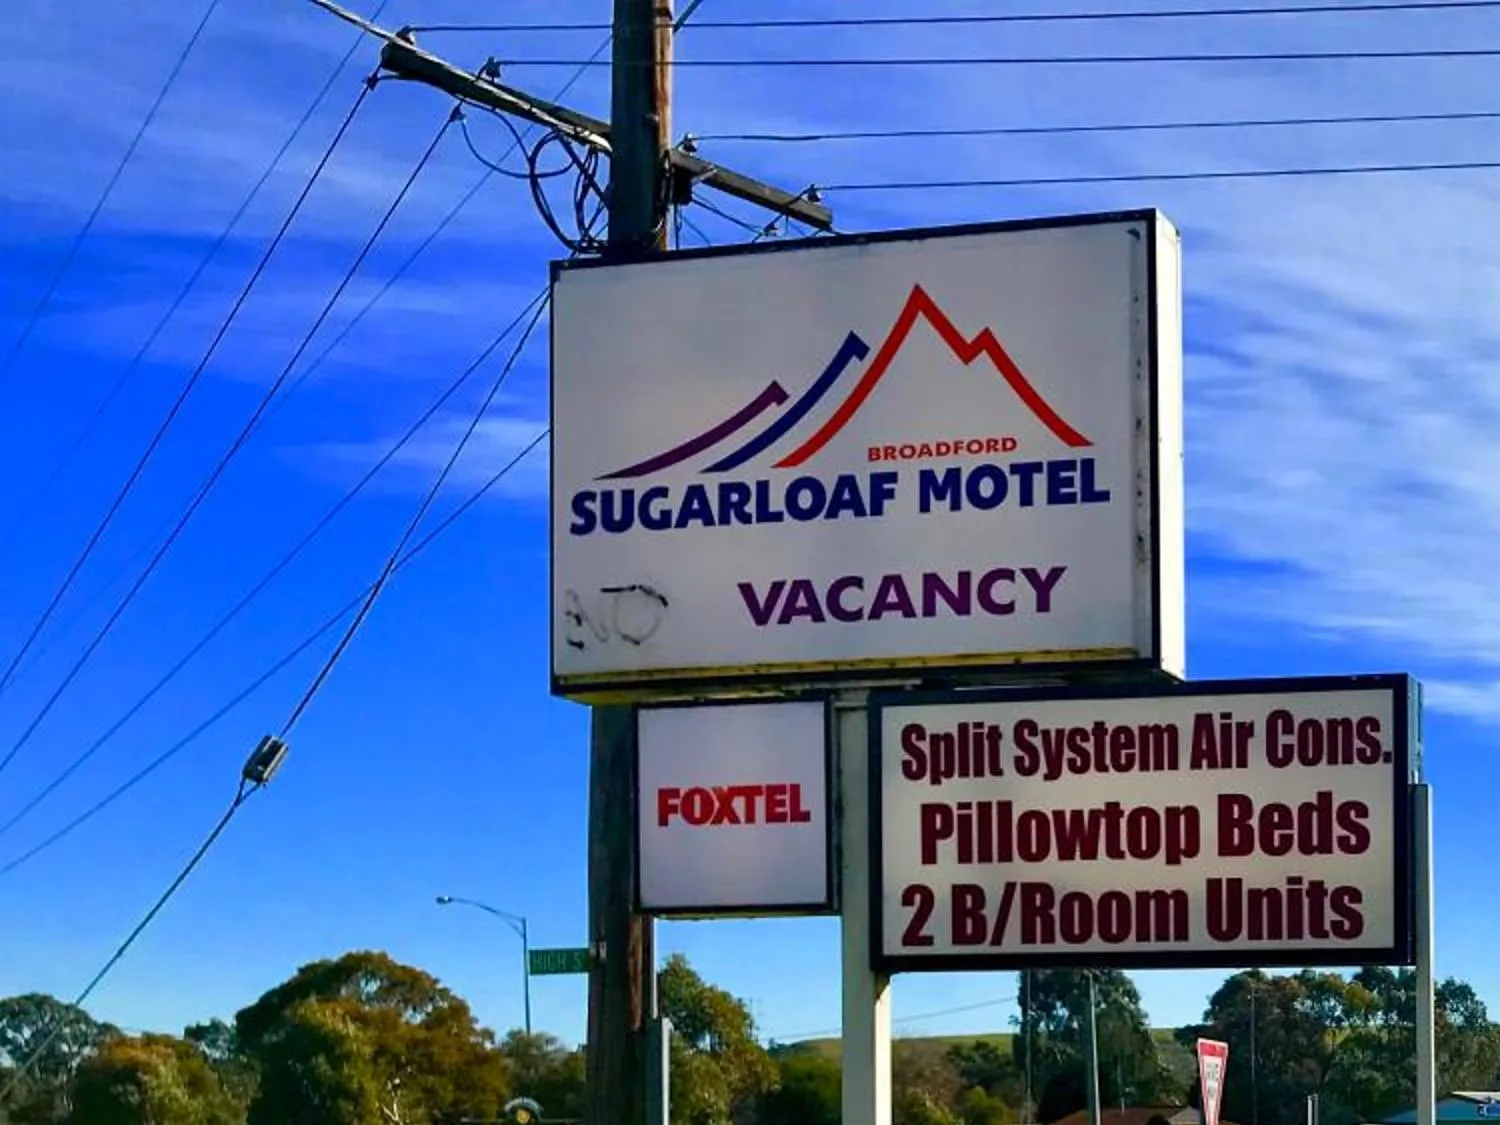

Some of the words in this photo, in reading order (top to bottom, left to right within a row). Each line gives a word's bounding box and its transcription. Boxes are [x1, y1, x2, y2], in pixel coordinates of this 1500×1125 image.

[867, 437, 1018, 463] BROADFORD
[569, 471, 899, 537] SUGARLOAF
[919, 457, 1111, 514] MOTEL
[737, 565, 1068, 627] VACANCY
[901, 721, 1004, 786] Split
[1013, 718, 1179, 783] System
[1190, 711, 1256, 771] Air
[1266, 708, 1394, 769] Cons.
[657, 783, 812, 828] FOXTEL
[920, 799, 1201, 866] Pillowtop
[1217, 789, 1371, 858] Beds
[901, 883, 935, 948] 2
[951, 880, 1190, 948] B/Room
[1205, 875, 1365, 944] Units
